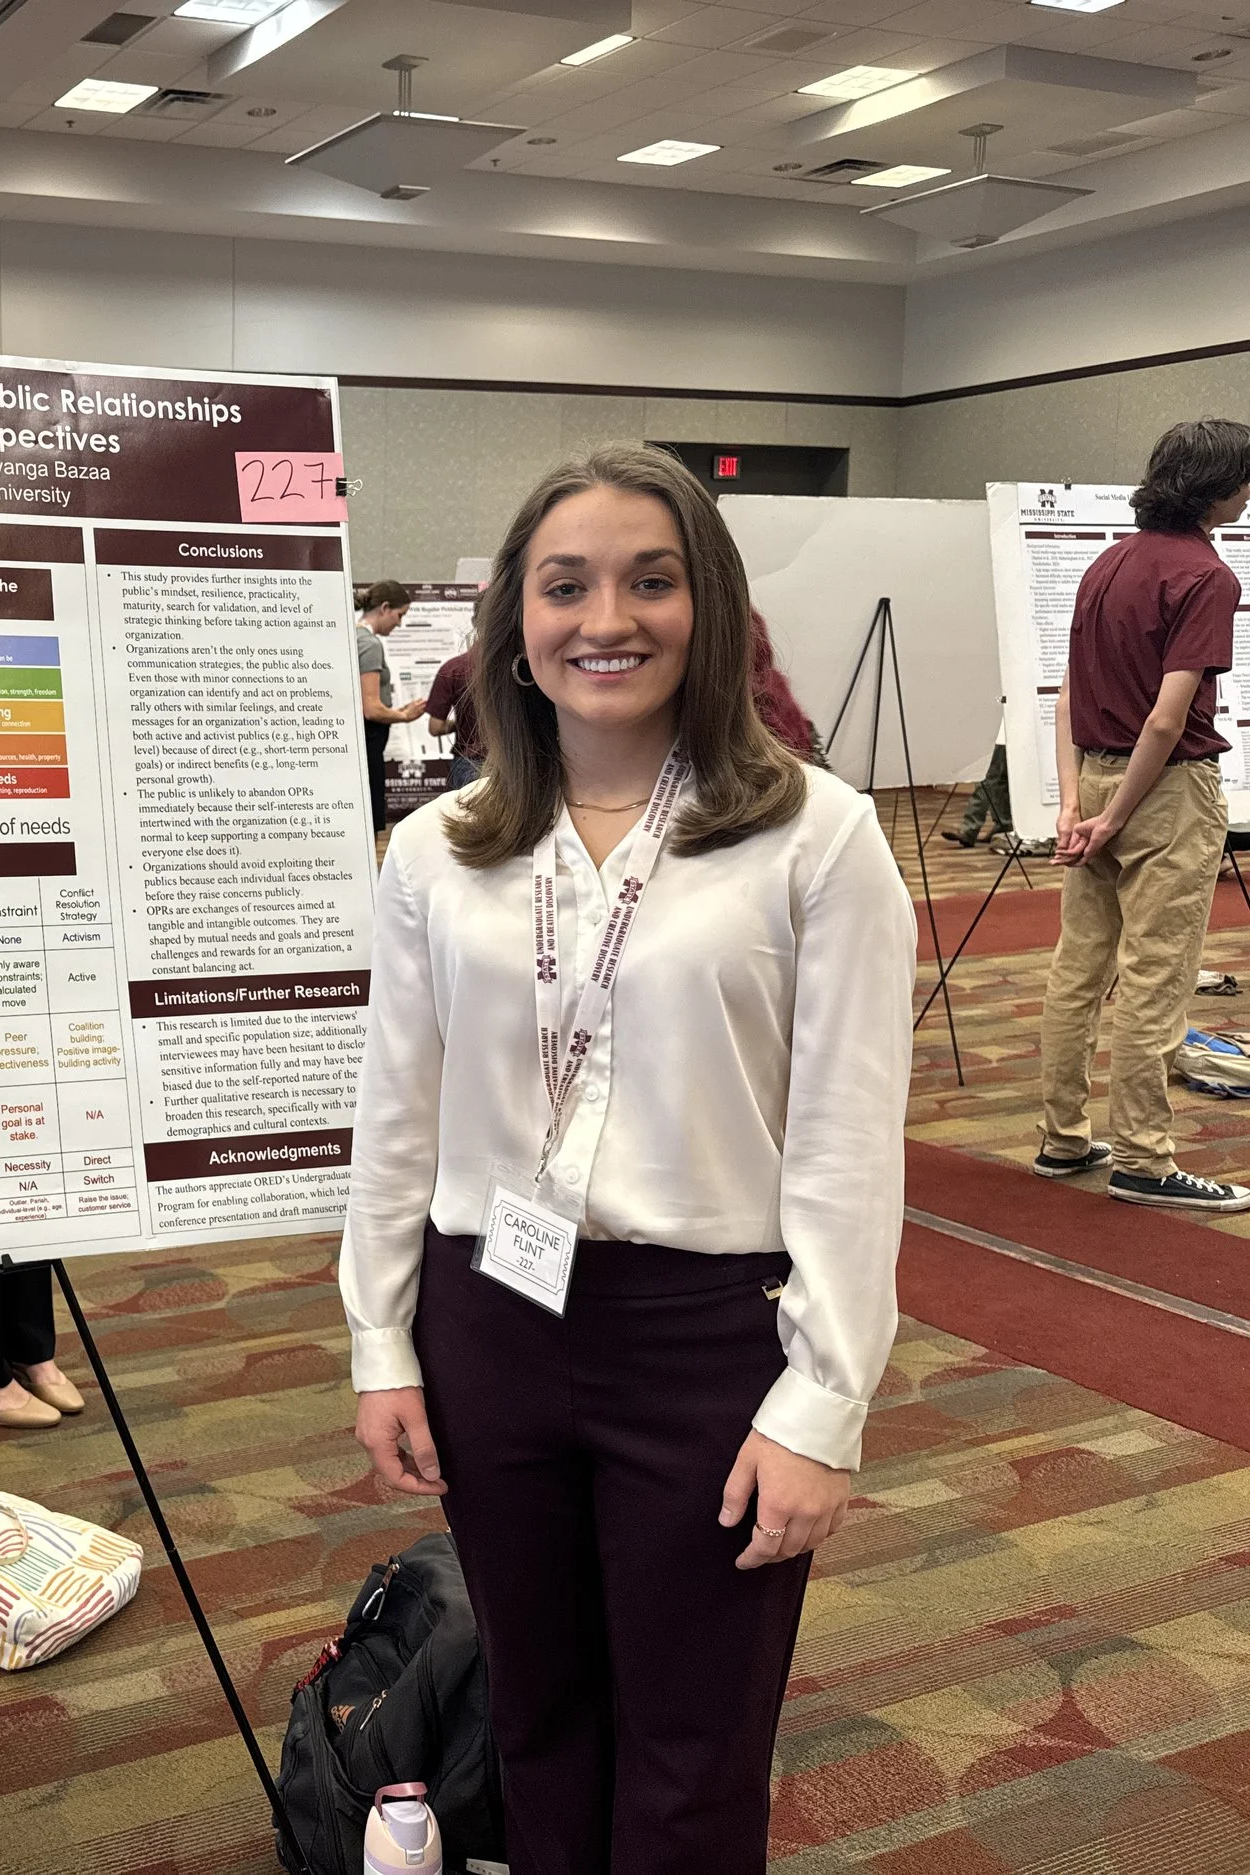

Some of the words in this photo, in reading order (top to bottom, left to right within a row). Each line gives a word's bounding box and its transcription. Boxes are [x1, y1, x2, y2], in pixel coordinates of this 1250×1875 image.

[61, 389, 242, 427] Relationships
[54, 460, 110, 480] Bazaa
[718, 456, 738, 477] EXIT
[241, 459, 333, 503] 227
[1020, 508, 1056, 517] MISSISSIPPI
[1057, 509, 1075, 517] STATE
[178, 543, 262, 558] Conclusions
[120, 571, 141, 580] This
[143, 572, 167, 584] study
[170, 573, 208, 584] provides
[211, 574, 240, 583] further
[243, 575, 277, 586] insights
[298, 576, 311, 585] the
[0, 817, 15, 834] of
[20, 817, 70, 834] needs
[643, 801, 660, 832] DISCOVERY
[652, 809, 670, 839] RESEARCH
[59, 888, 93, 897] Conflict
[535, 874, 543, 903] RESEARCH
[545, 876, 553, 909] DISCOVERY
[55, 899, 100, 908] Resolution
[611, 906, 622, 919] AND
[60, 912, 96, 921] Strategy
[546, 910, 554, 938] CREATIVE
[62, 932, 100, 941] Activism
[535, 904, 544, 955] UNDERGRADUATE
[602, 919, 618, 949] CREATIVE
[611, 906, 634, 958] UNDERGRADUATE
[547, 939, 555, 951] AND
[591, 948, 608, 983] DISCOVERY
[600, 957, 617, 990] RESEARCH
[154, 987, 290, 1005] Limitations/Further
[294, 982, 359, 997] Research
[209, 1142, 340, 1164] Acknowledgments
[4, 1160, 50, 1171] Necessity
[504, 1213, 560, 1251] CAROLINE
[513, 1235, 545, 1260] FLINT
